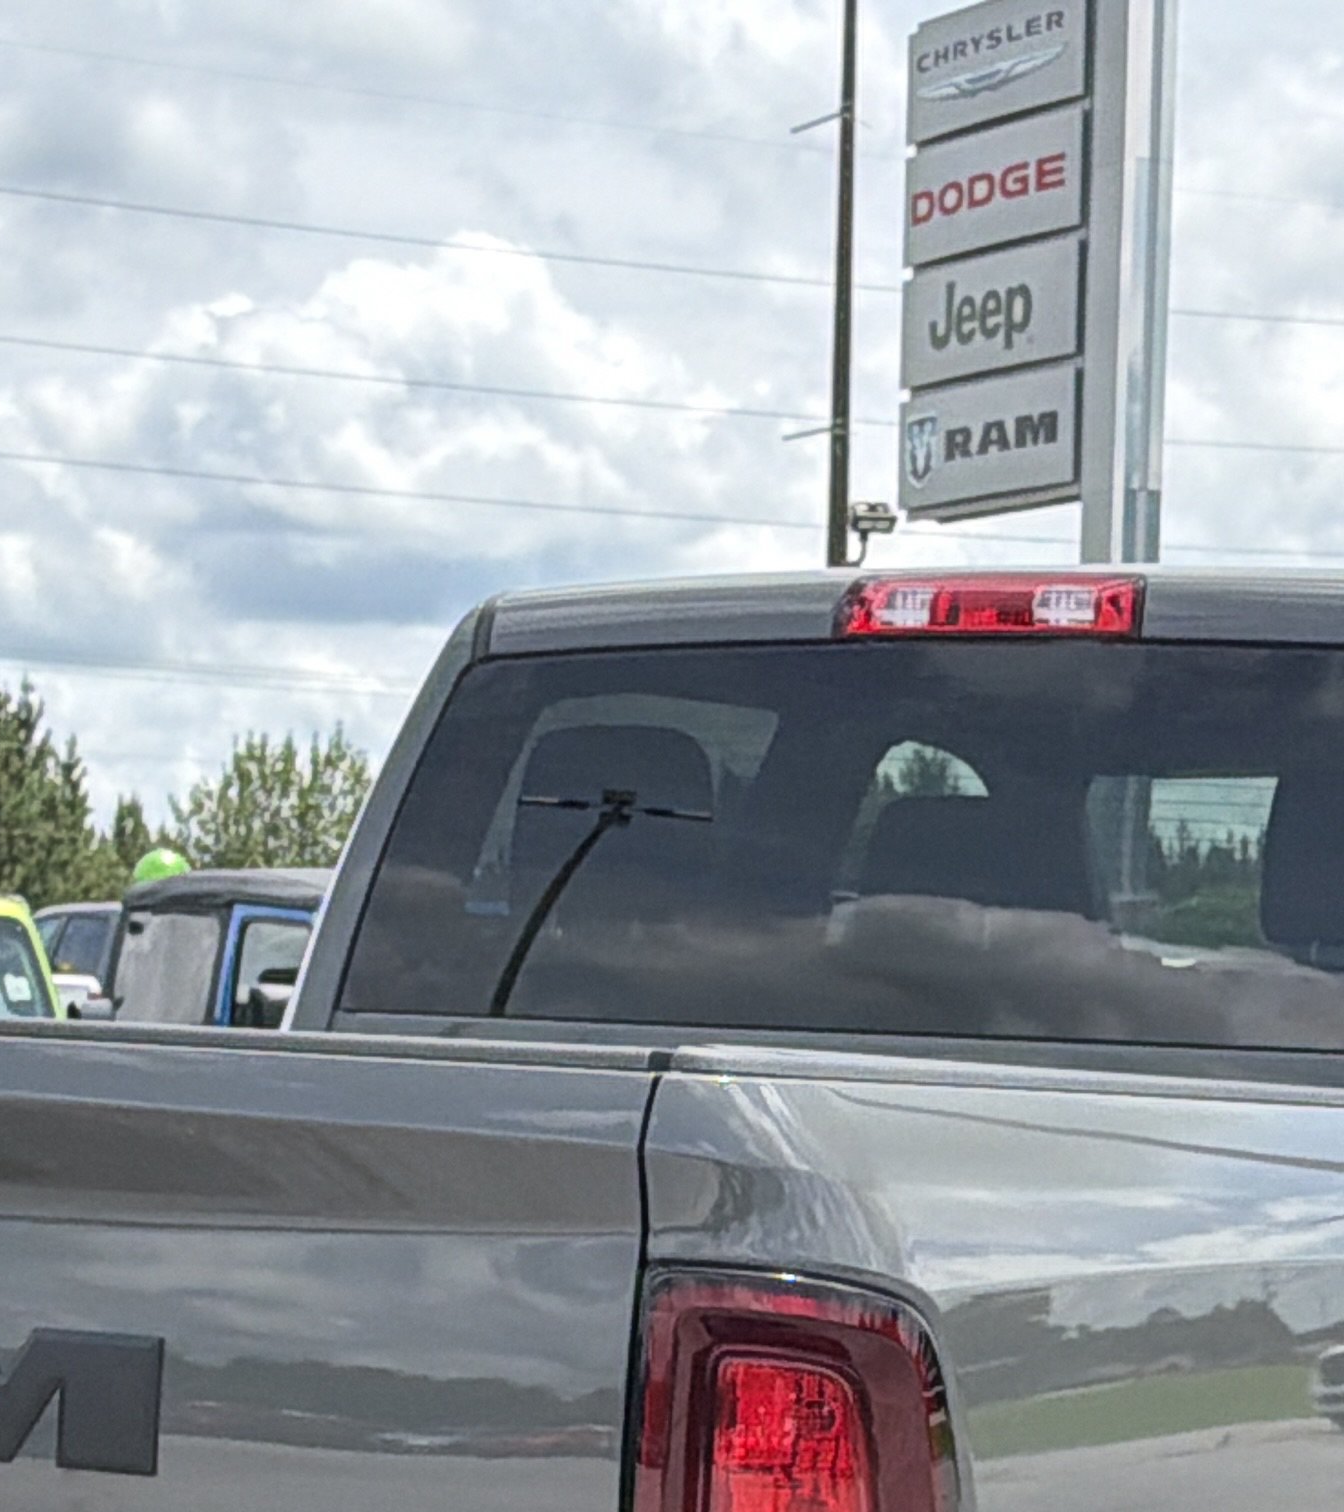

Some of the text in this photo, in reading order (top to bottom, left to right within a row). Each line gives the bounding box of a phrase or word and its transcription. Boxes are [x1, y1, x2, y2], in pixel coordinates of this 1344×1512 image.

[916, 10, 1065, 73] CHRYSLER
[911, 152, 1066, 228] DODGE
[929, 281, 1033, 351] Jeep
[944, 410, 1059, 463] RAM
